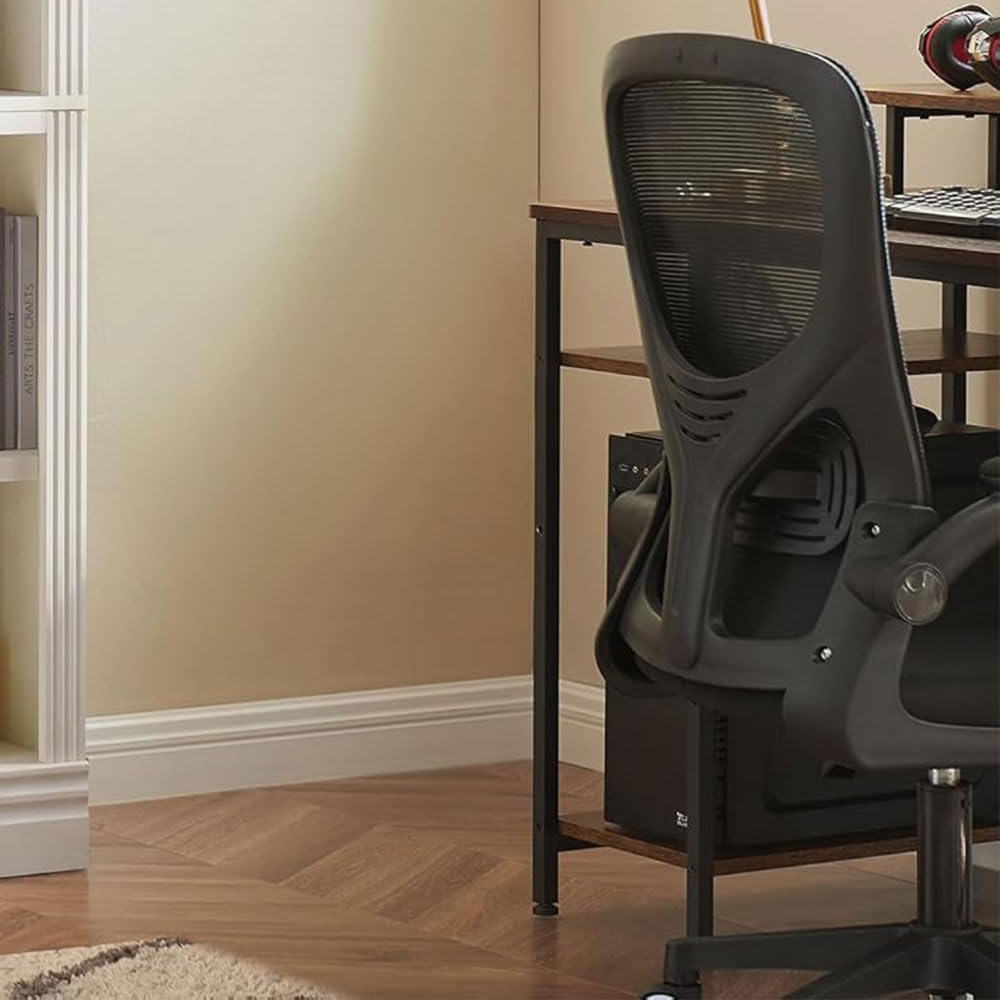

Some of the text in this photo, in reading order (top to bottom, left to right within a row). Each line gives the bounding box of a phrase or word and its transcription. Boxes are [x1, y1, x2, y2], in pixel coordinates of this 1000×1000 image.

[23, 282, 34, 395] ARTS THE CRAFTS
